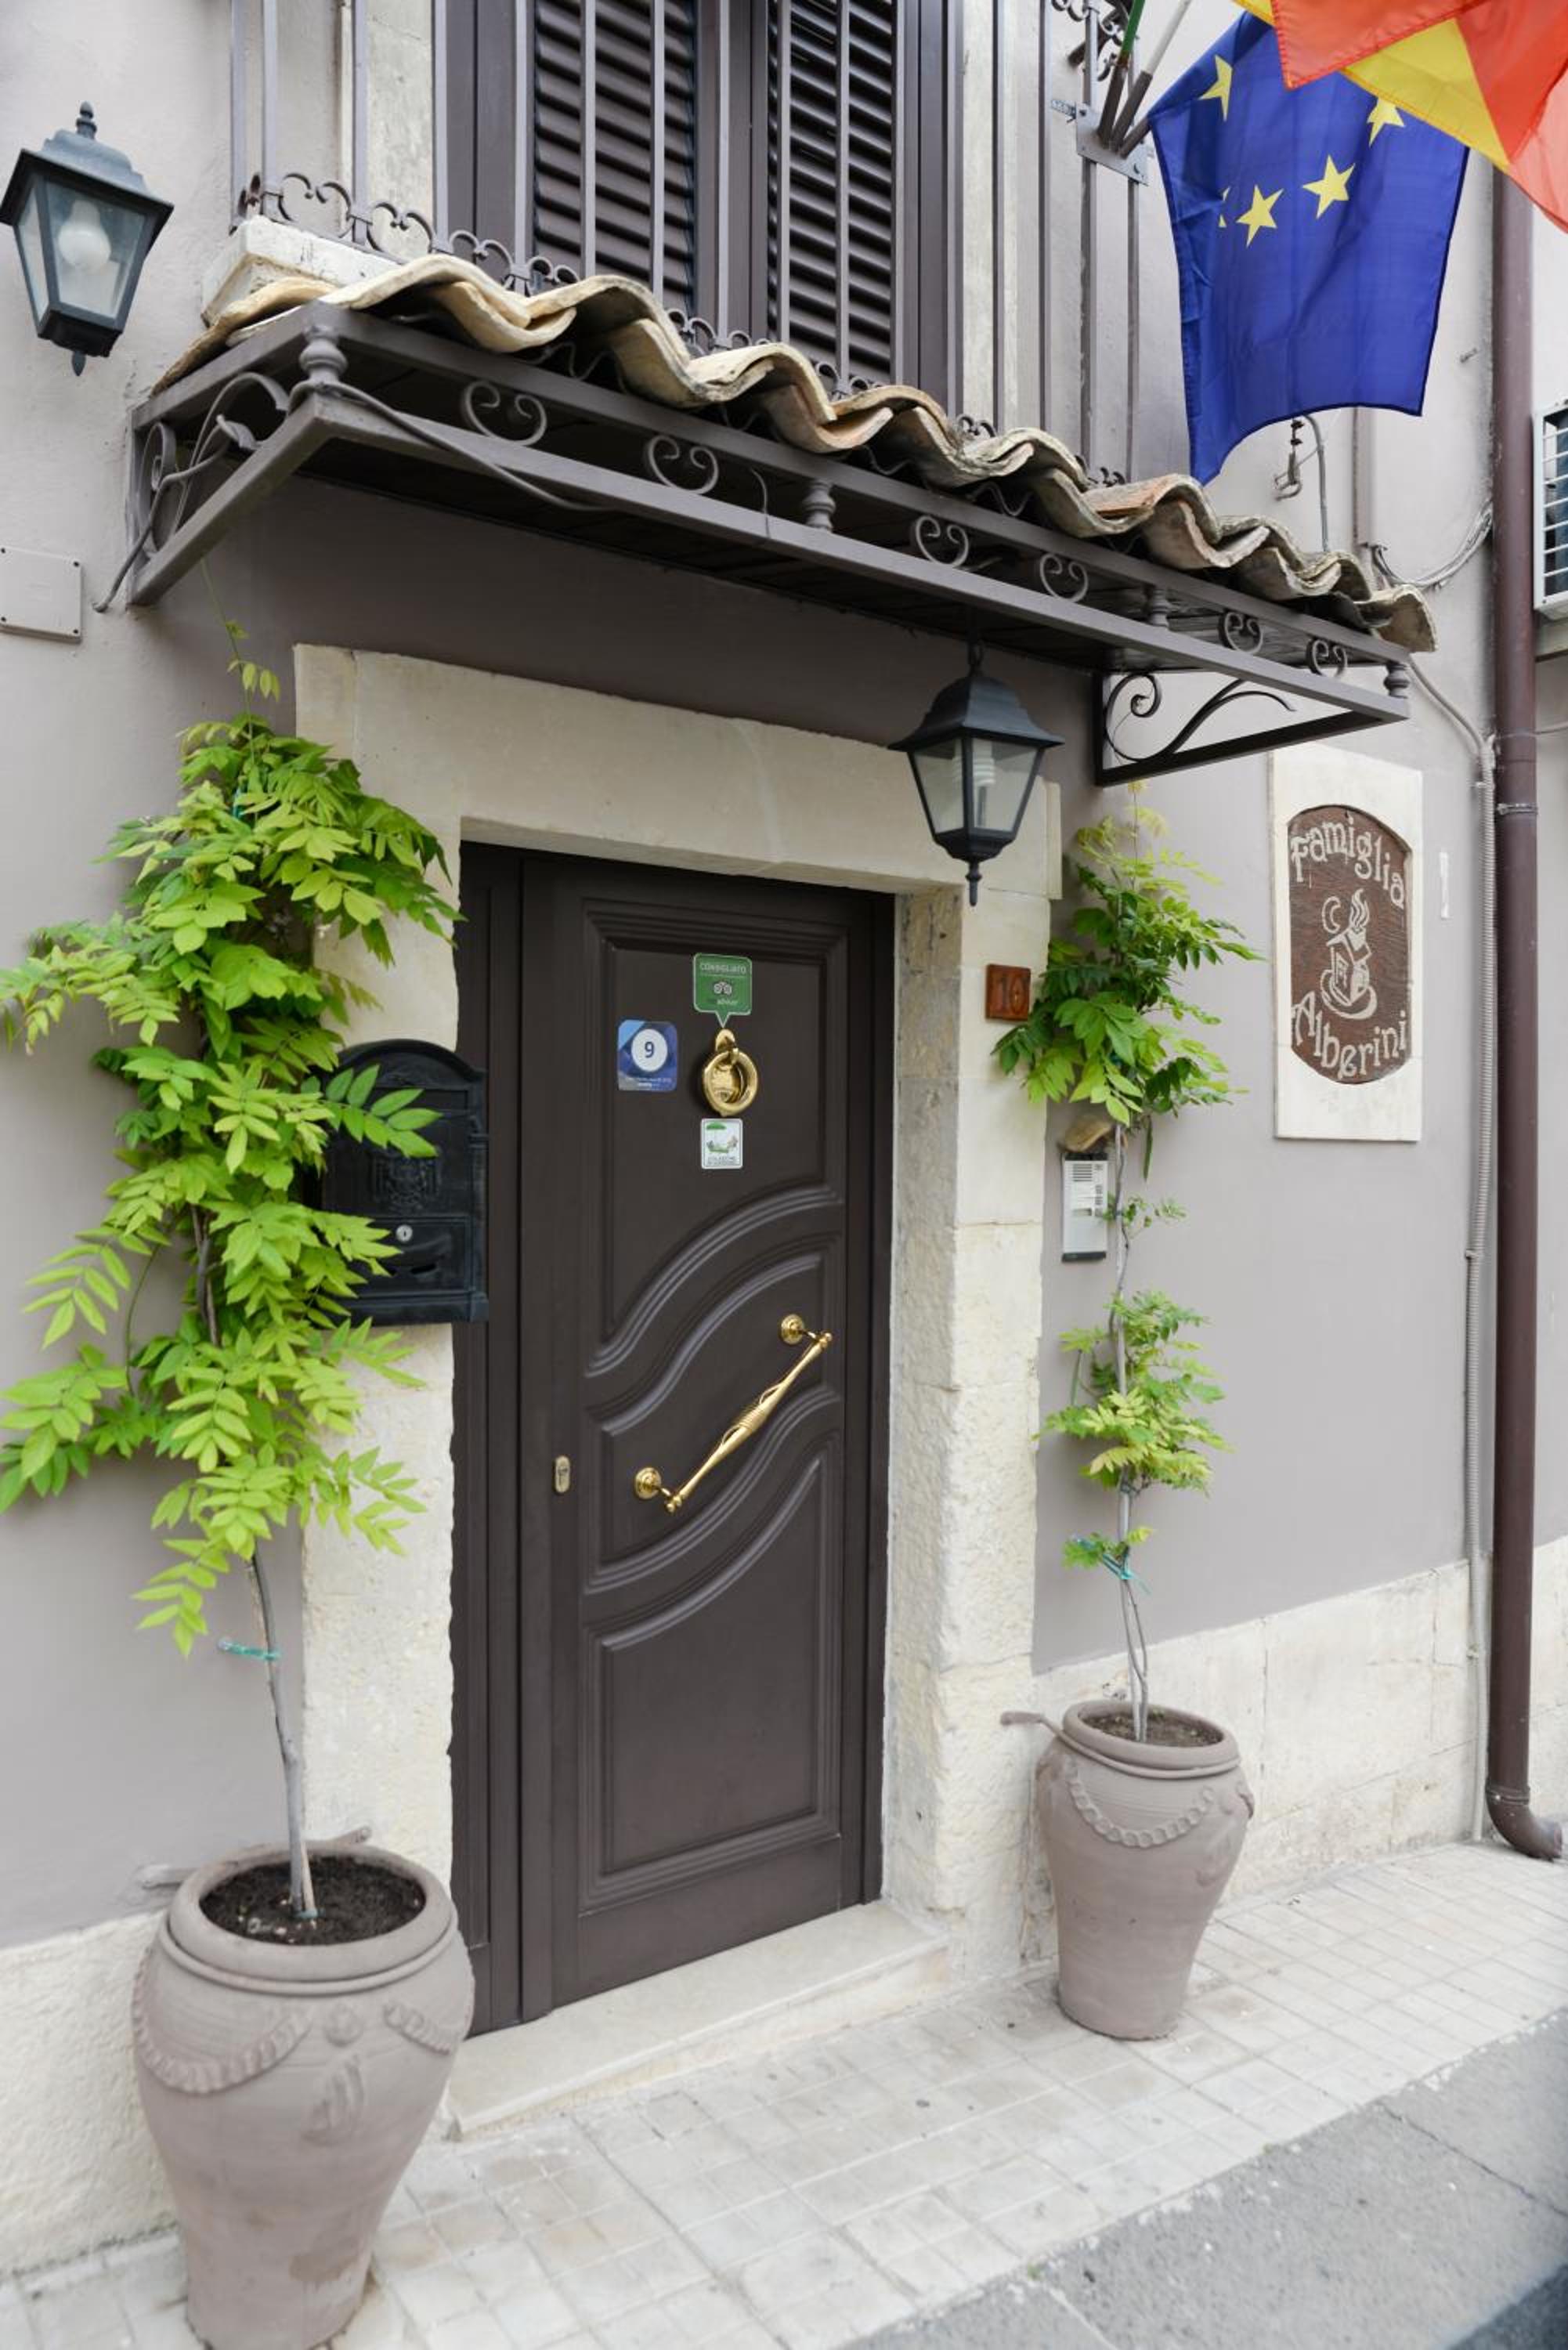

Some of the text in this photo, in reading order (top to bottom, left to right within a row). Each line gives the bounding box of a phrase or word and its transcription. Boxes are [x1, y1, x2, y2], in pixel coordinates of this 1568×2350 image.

[1290, 814, 1406, 910] Famiglia
[644, 1041, 656, 1058] 9
[1290, 991, 1407, 1080] Alberini
